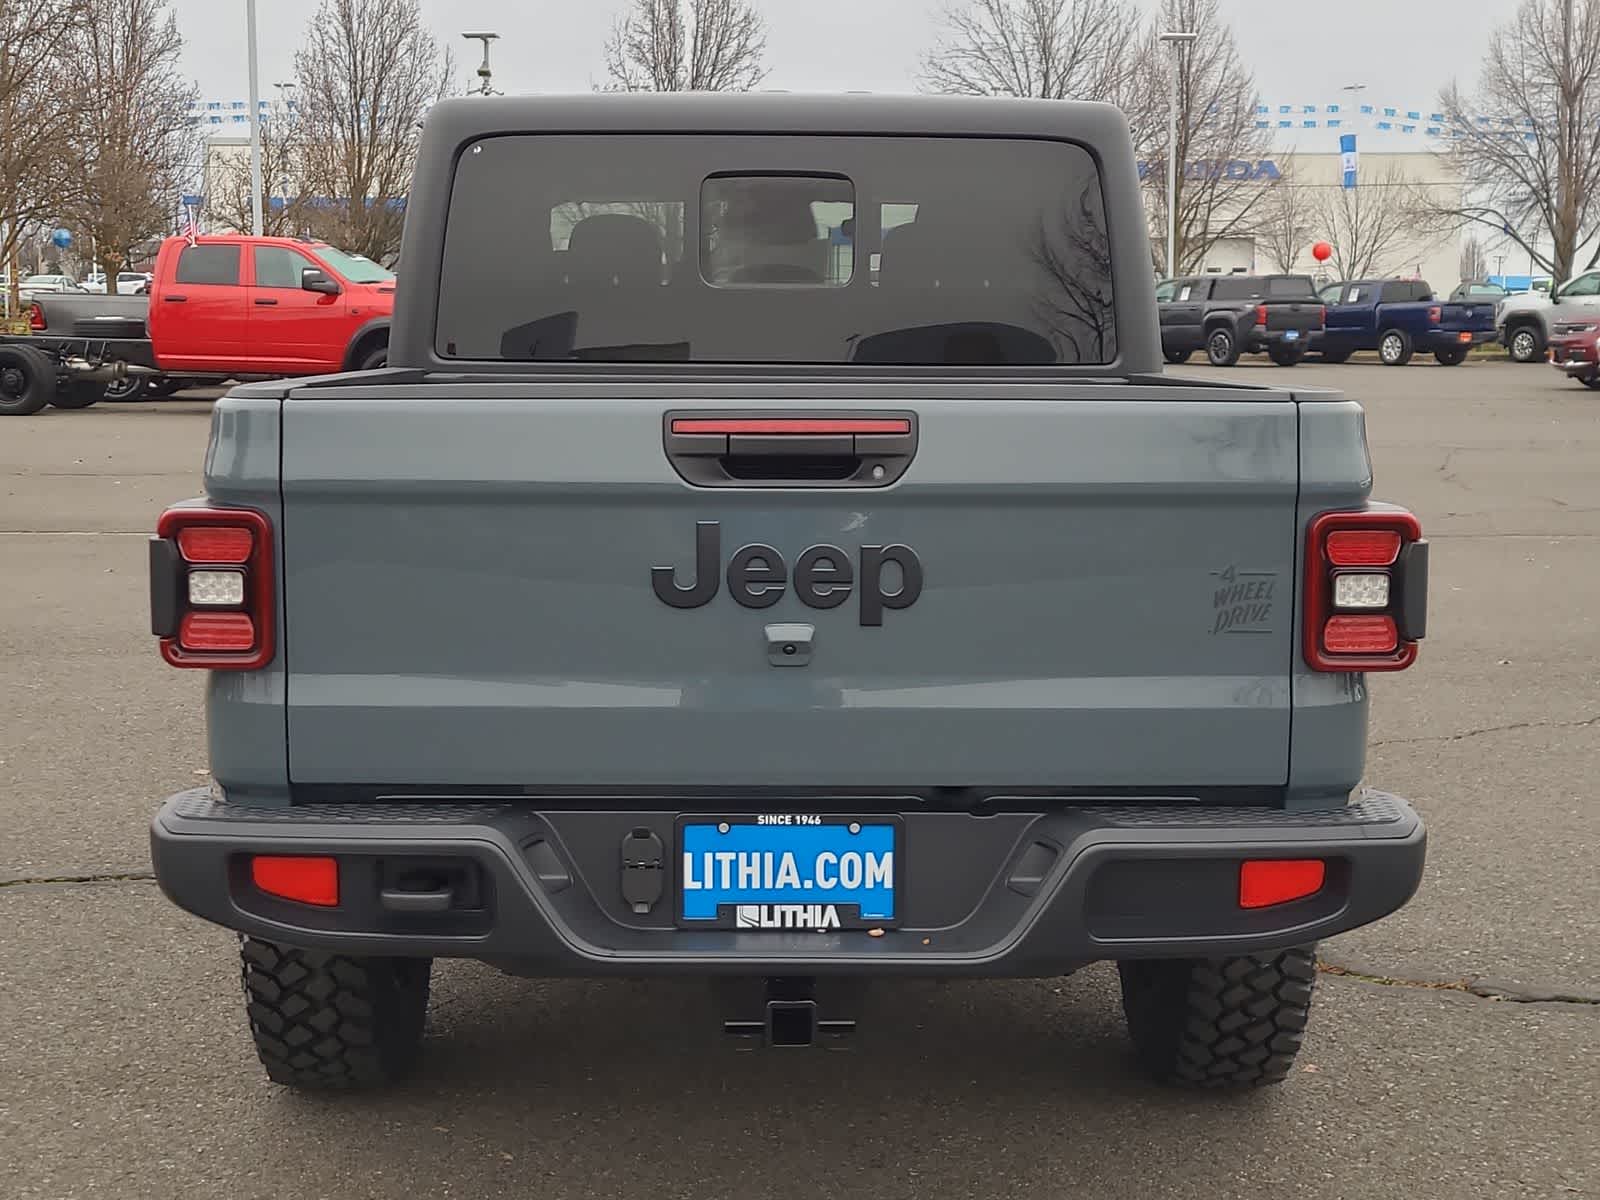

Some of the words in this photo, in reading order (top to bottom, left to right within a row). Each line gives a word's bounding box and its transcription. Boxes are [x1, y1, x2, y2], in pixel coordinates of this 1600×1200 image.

[651, 520, 923, 627] Jeep
[1220, 565, 1236, 583] 4
[1213, 581, 1275, 608] WHEEL
[1213, 602, 1273, 632] DRIVE
[757, 815, 793, 825] SINCE
[795, 815, 821, 825] 1946
[683, 852, 893, 889] LITHIA.COM
[760, 905, 841, 928] LITHIA
